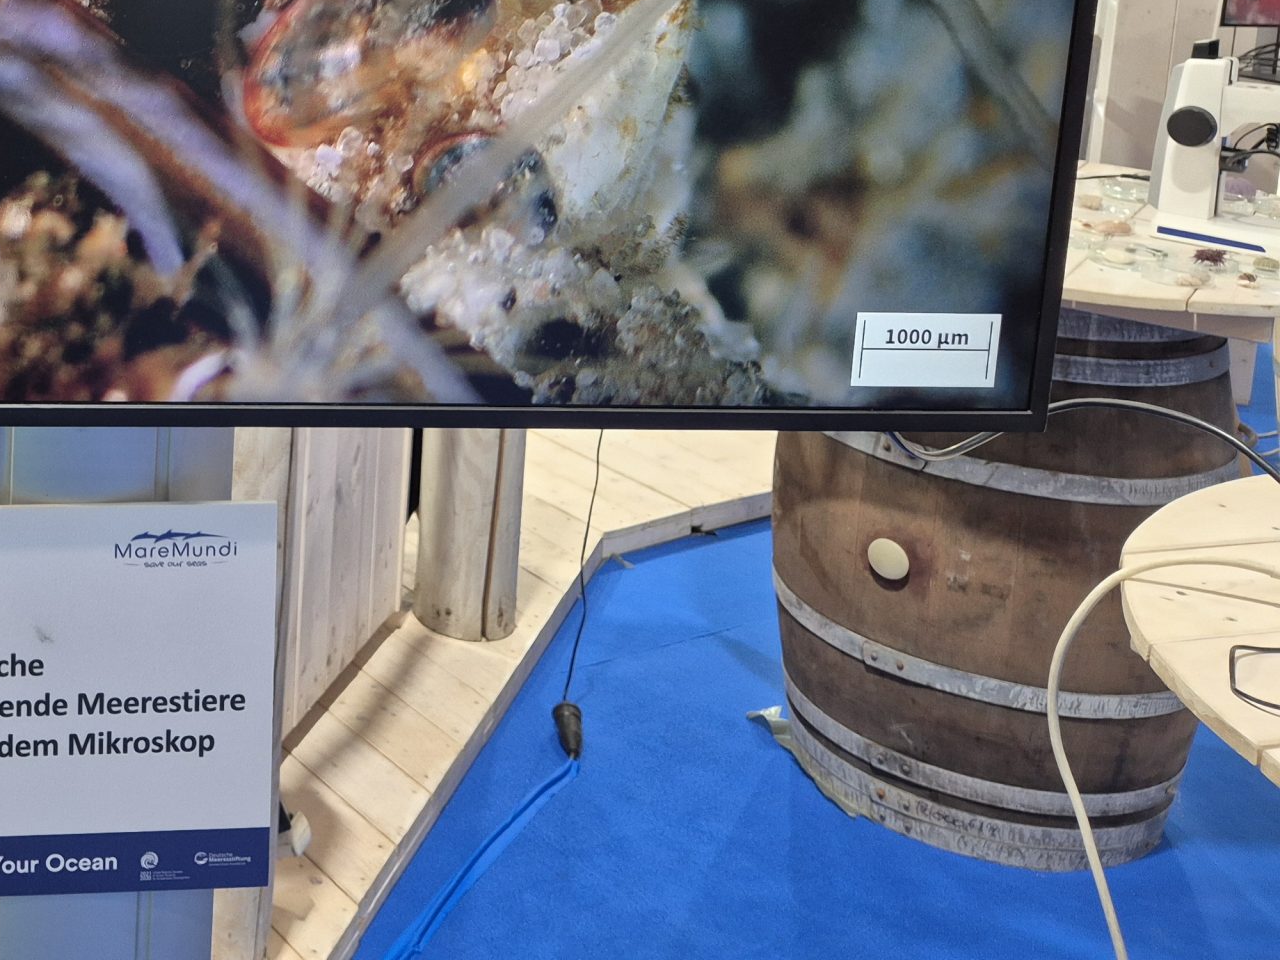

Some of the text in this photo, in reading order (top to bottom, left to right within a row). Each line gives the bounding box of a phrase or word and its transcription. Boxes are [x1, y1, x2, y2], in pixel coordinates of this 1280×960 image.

[885, 329, 932, 344] 1000
[114, 541, 238, 559] MareMundi
[77, 689, 246, 715] Meerestiere
[68, 729, 215, 757] Mikroskop
[45, 853, 118, 873] Ocean
